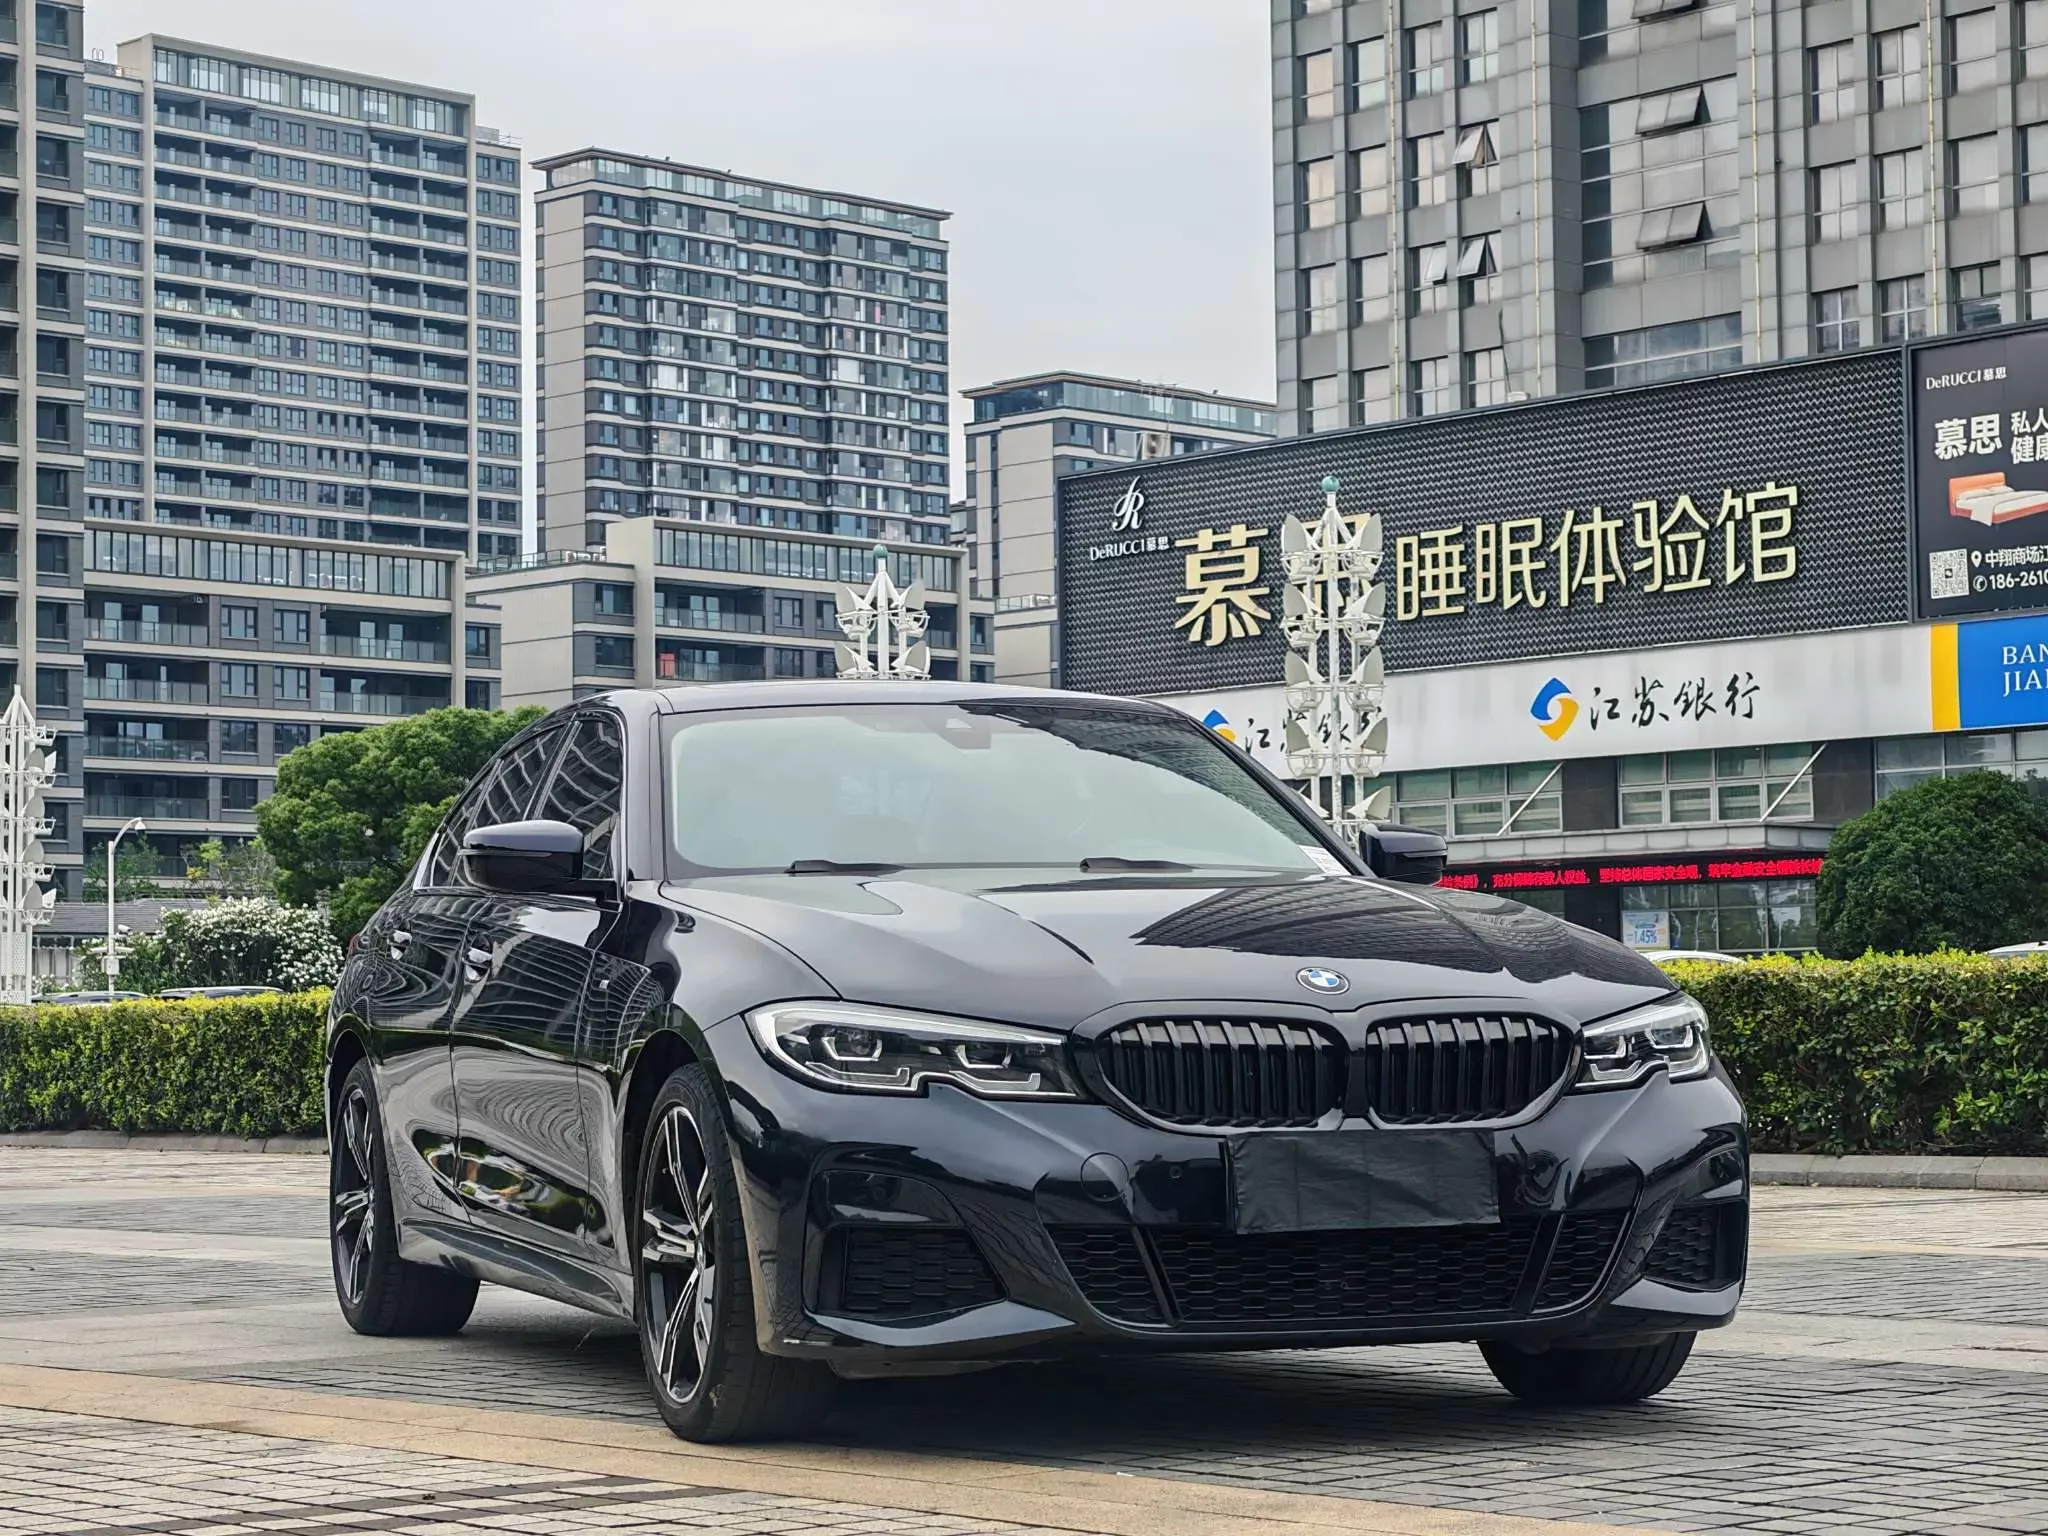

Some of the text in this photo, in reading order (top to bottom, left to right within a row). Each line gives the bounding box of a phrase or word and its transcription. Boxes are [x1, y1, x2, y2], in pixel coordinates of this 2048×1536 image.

[1926, 366, 2008, 390] DeRUCCI 慕思
[2011, 407, 2048, 436] 私人
[1934, 413, 2003, 461] 慕思
[1090, 538, 1145, 561] DeRUCCI
[2003, 667, 2048, 698] JIA
[1590, 671, 1760, 729] 江苏银行
